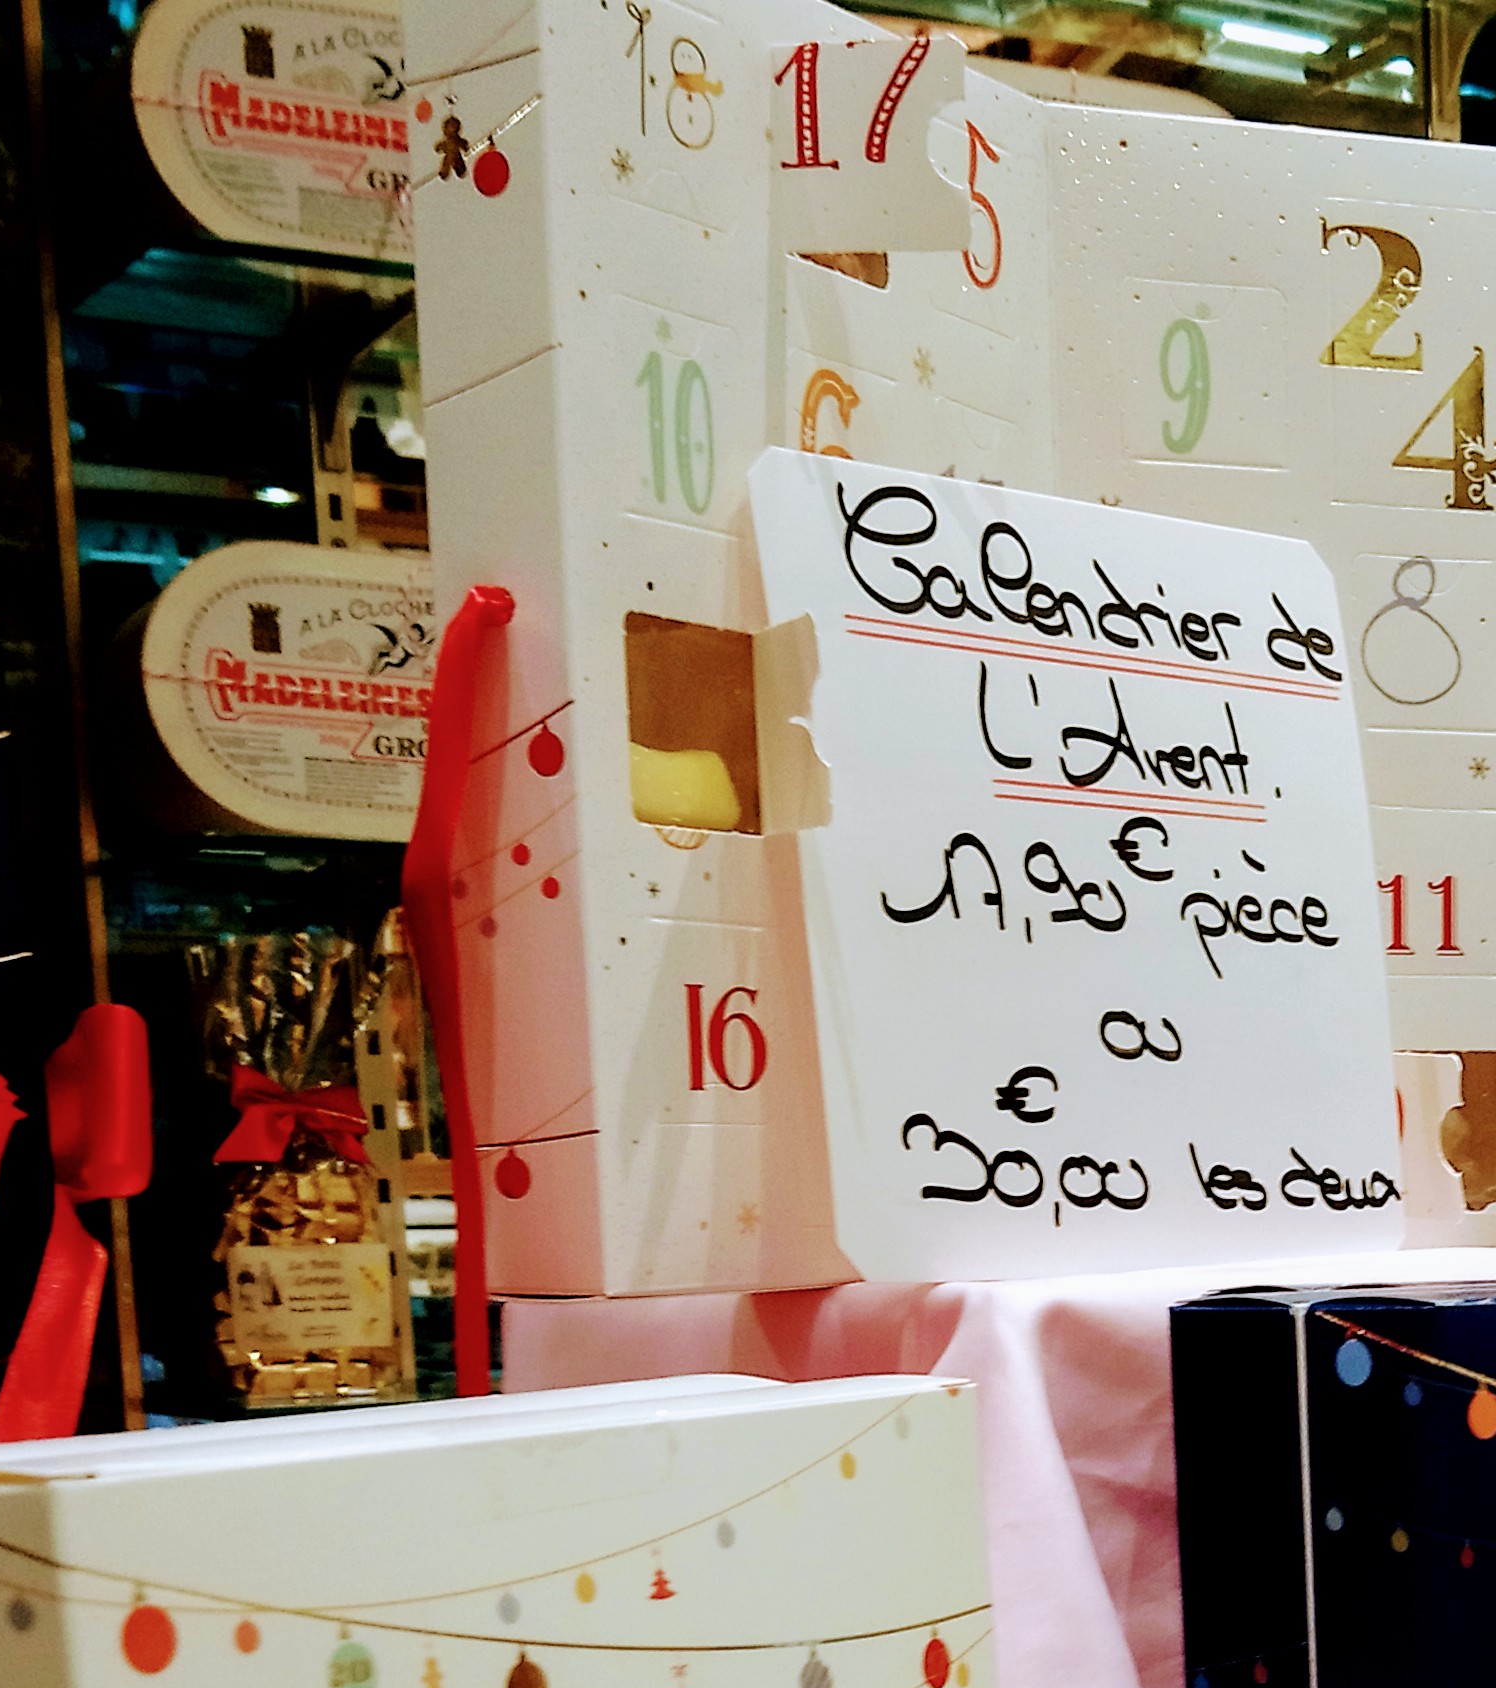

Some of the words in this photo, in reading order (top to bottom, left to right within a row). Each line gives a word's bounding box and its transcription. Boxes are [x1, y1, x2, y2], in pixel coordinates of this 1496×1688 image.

[625, 2, 723, 150] 18
[774, 26, 931, 170] 17
[962, 119, 1002, 289] 5
[635, 351, 714, 516] 10
[1160, 318, 1211, 454] 9
[300, 618, 312, 633] A
[317, 607, 343, 627] LA
[837, 482, 1242, 661] Calendrier
[1267, 592, 1343, 681] de
[1361, 556, 1461, 705] 8
[1180, 849, 1340, 979] pièce
[1377, 874, 1464, 956] 11
[684, 983, 767, 1091] 16
[1099, 1010, 1183, 1061] ou
[1188, 1142, 1269, 1212] les
[1280, 1146, 1406, 1212] deux
